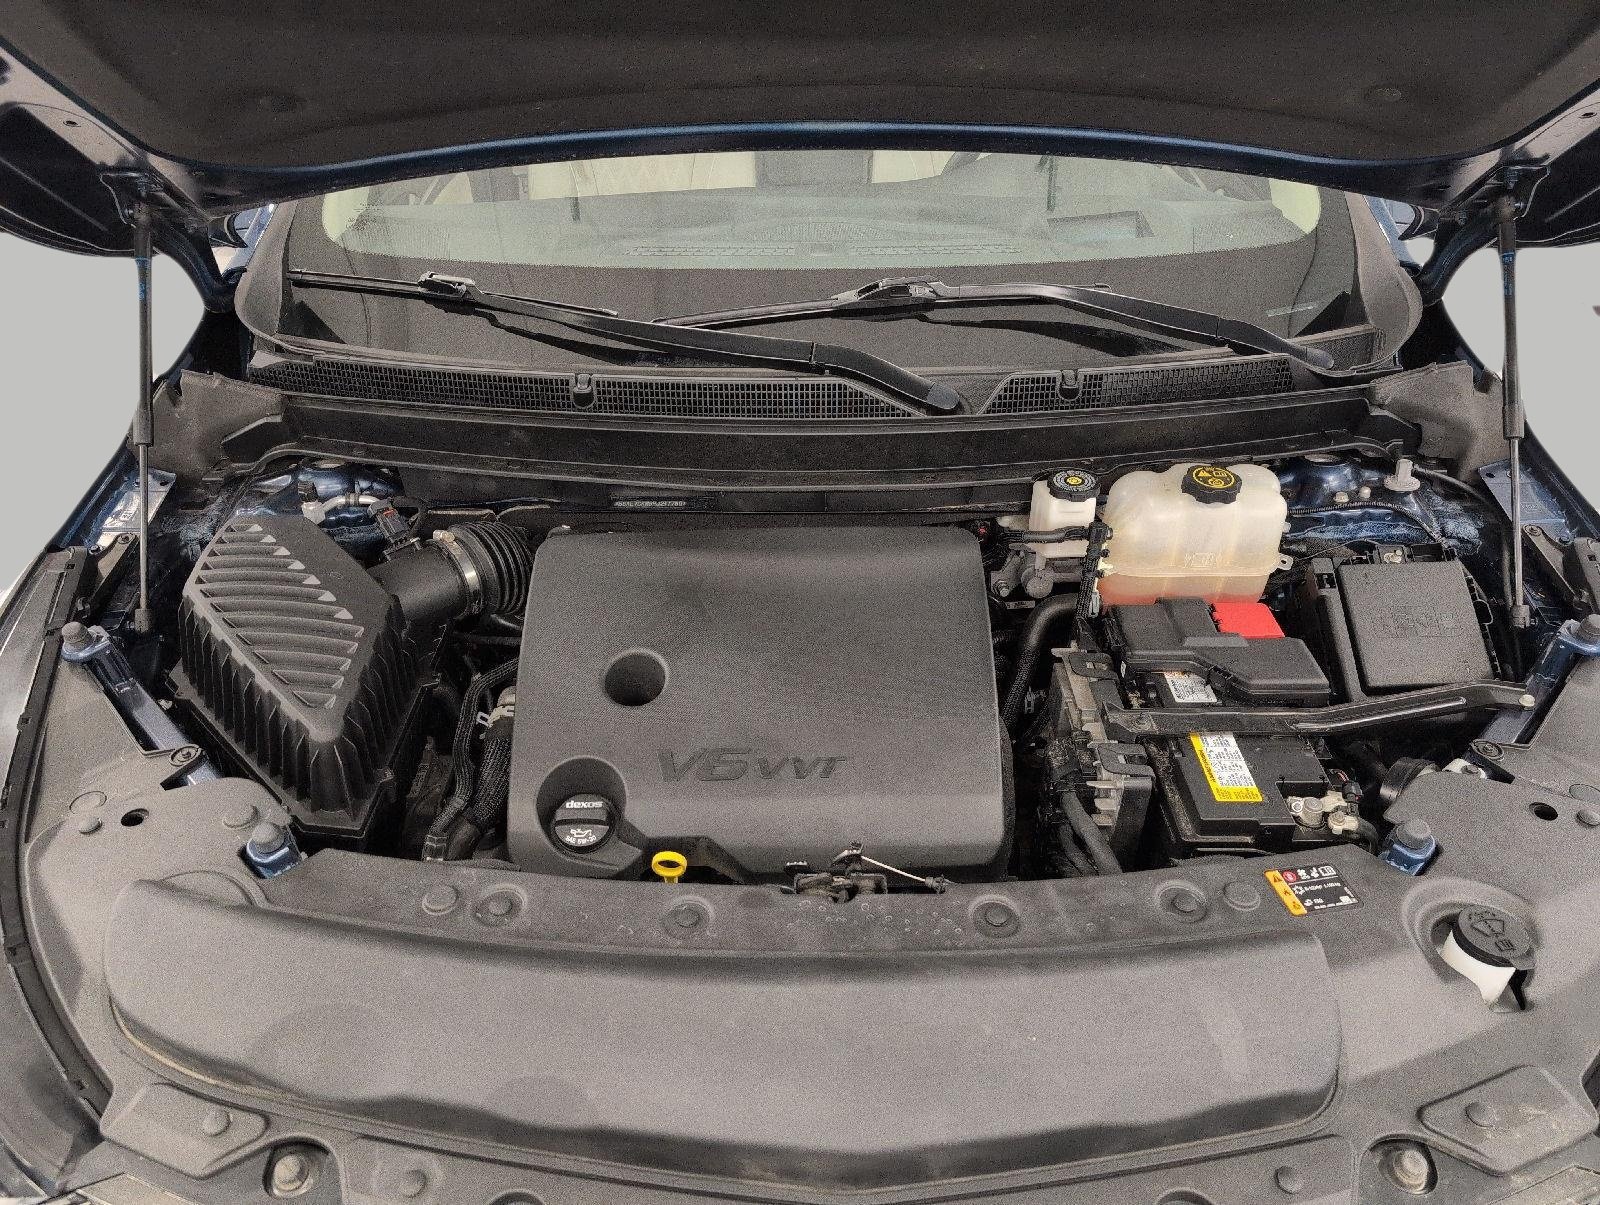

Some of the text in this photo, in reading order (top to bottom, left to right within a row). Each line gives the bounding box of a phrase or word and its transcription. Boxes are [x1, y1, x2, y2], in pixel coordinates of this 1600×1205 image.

[657, 749, 848, 782] V6 VVT
[565, 800, 604, 809] dexos
